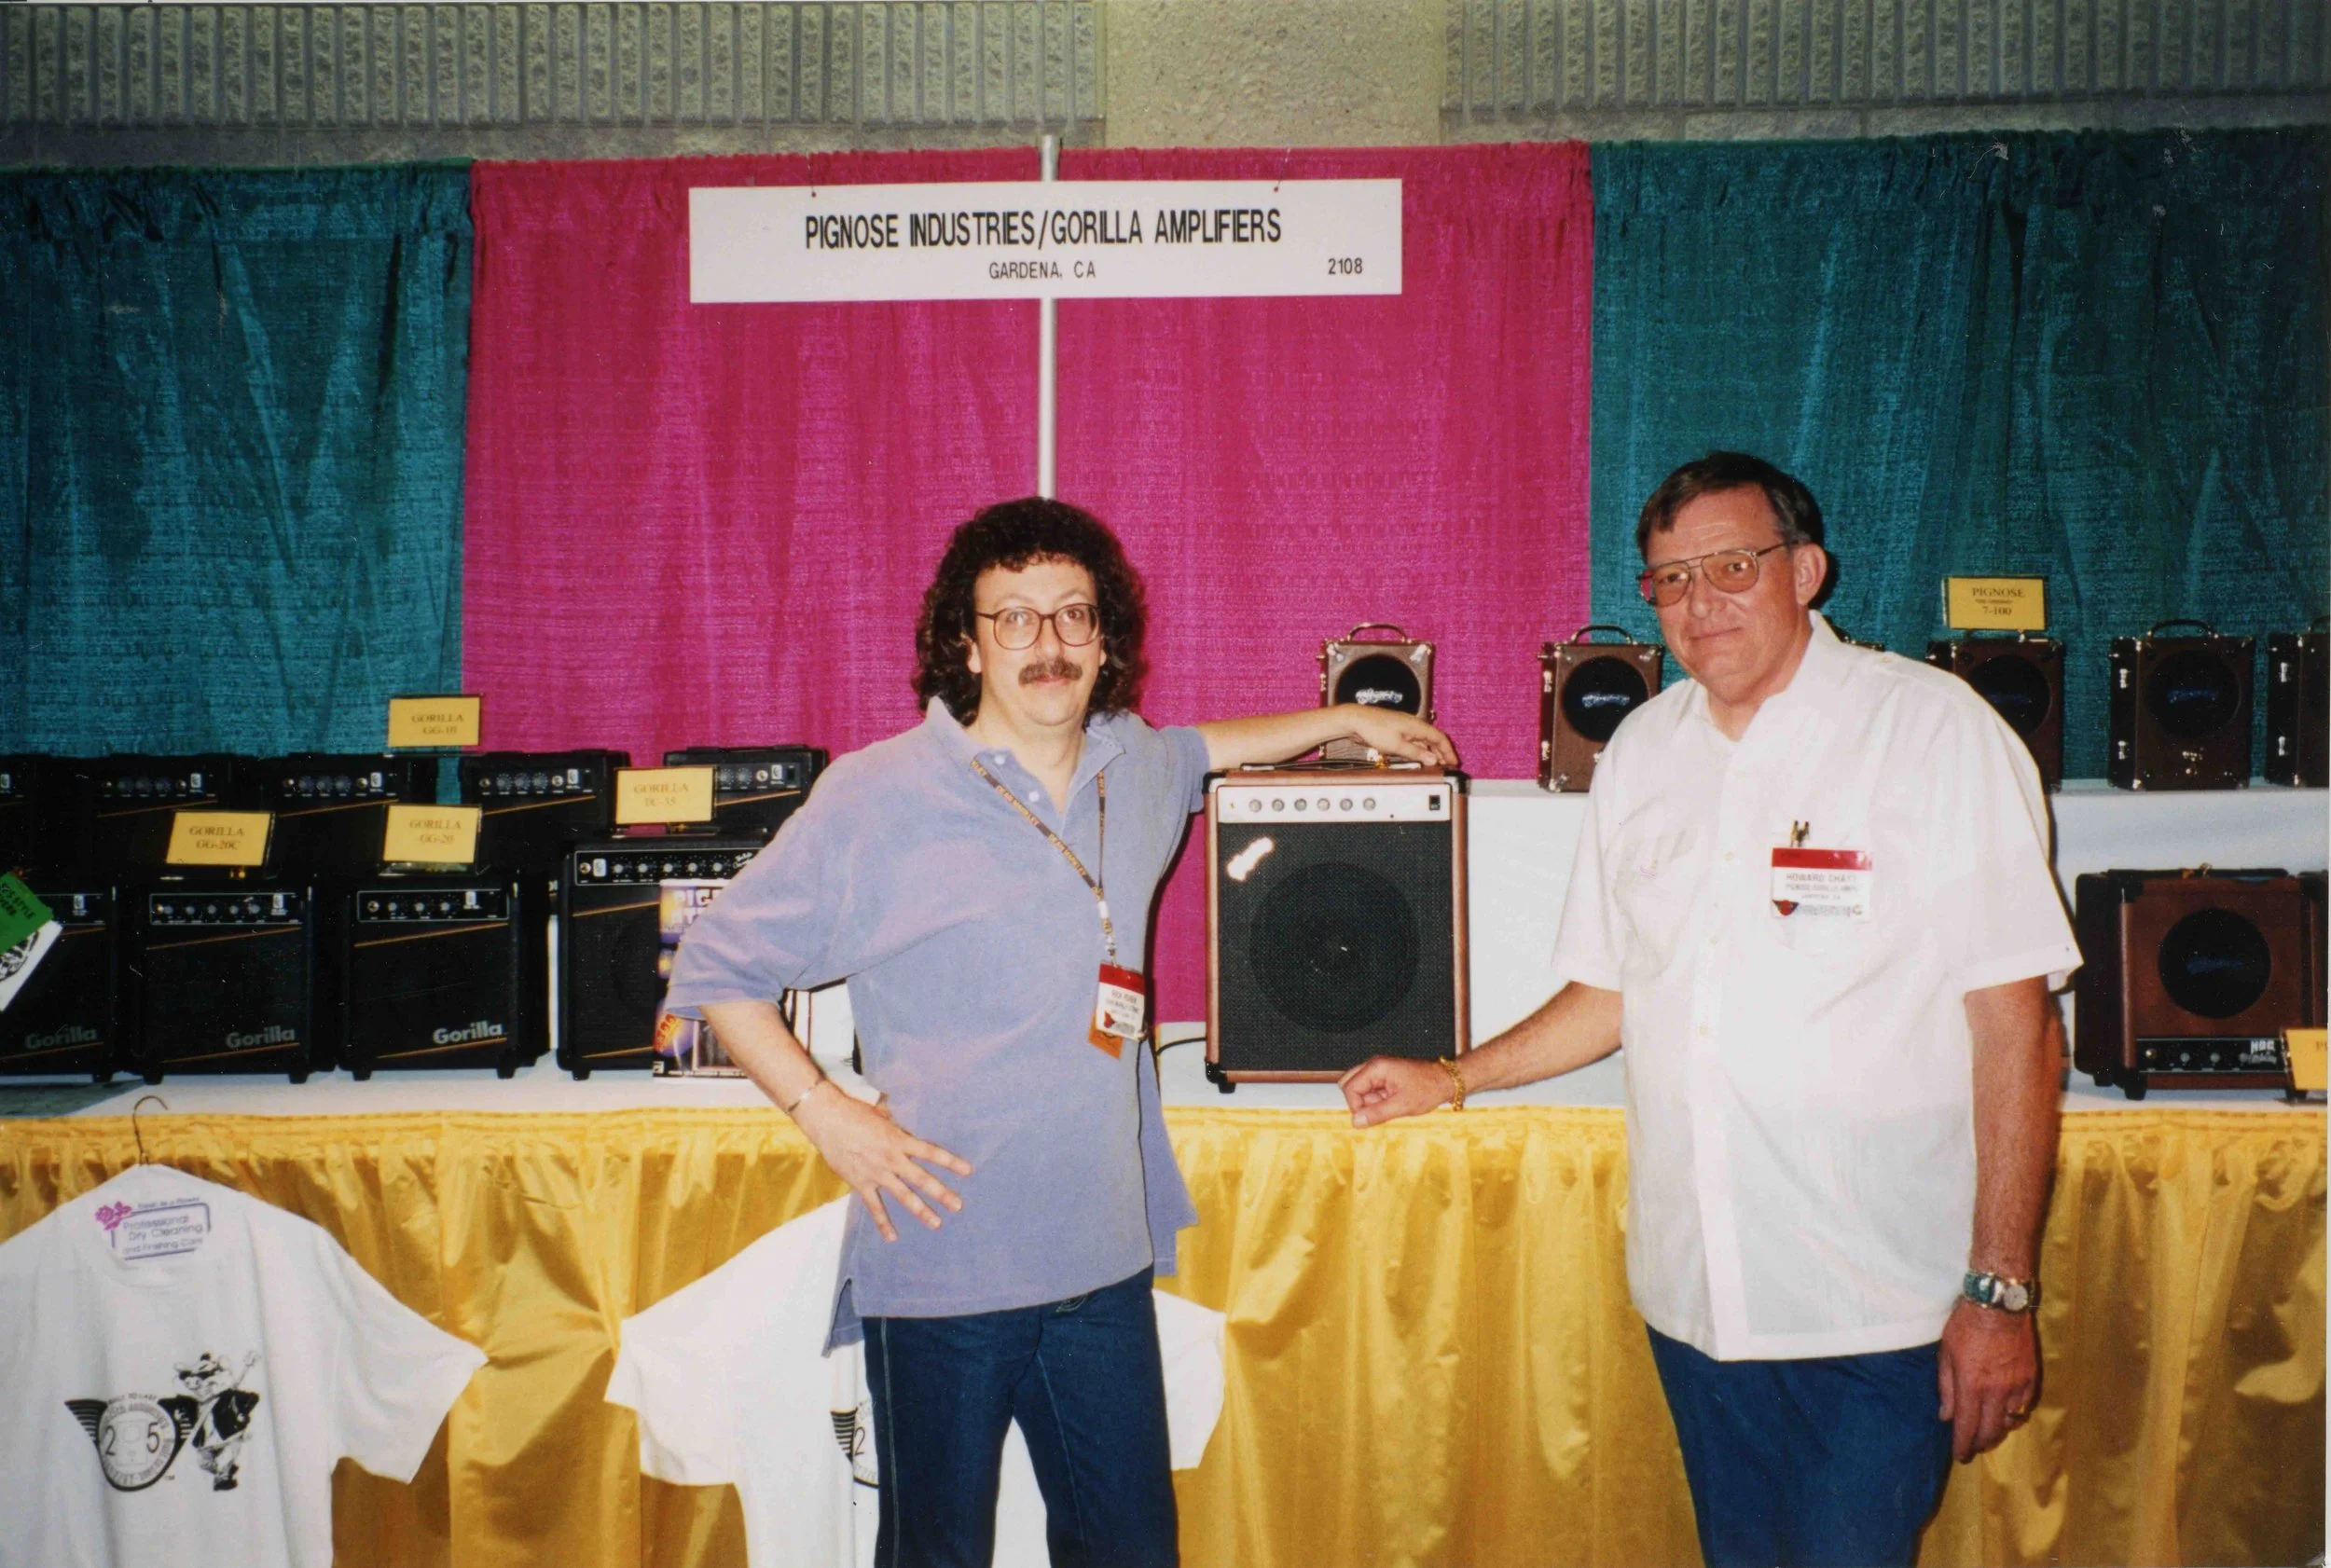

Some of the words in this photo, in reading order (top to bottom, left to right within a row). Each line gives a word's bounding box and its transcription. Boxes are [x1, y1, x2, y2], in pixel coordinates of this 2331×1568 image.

[806, 213, 899, 249] PIGNOSE
[910, 210, 1143, 250] INDUSTRIES/GORILLA
[1154, 208, 1281, 243] AMPLIFIERS
[1074, 261, 1097, 279] CA
[1328, 257, 1363, 275] 2108
[1972, 587, 2026, 598] PIGNOSE
[1982, 606, 2012, 615] 7-100
[411, 713, 464, 723] GORILLA
[634, 783, 690, 793] GORILLA
[189, 826, 245, 837] GORILLA
[408, 819, 462, 830] GORILLA
[25, 1025, 98, 1050] Gorilla
[226, 1025, 296, 1049] Gorilla
[433, 1020, 504, 1045] Gorilla
[122, 1215, 189, 1231] Professional
[129, 1231, 147, 1242] Dry
[150, 1223, 203, 1238] Cleaning
